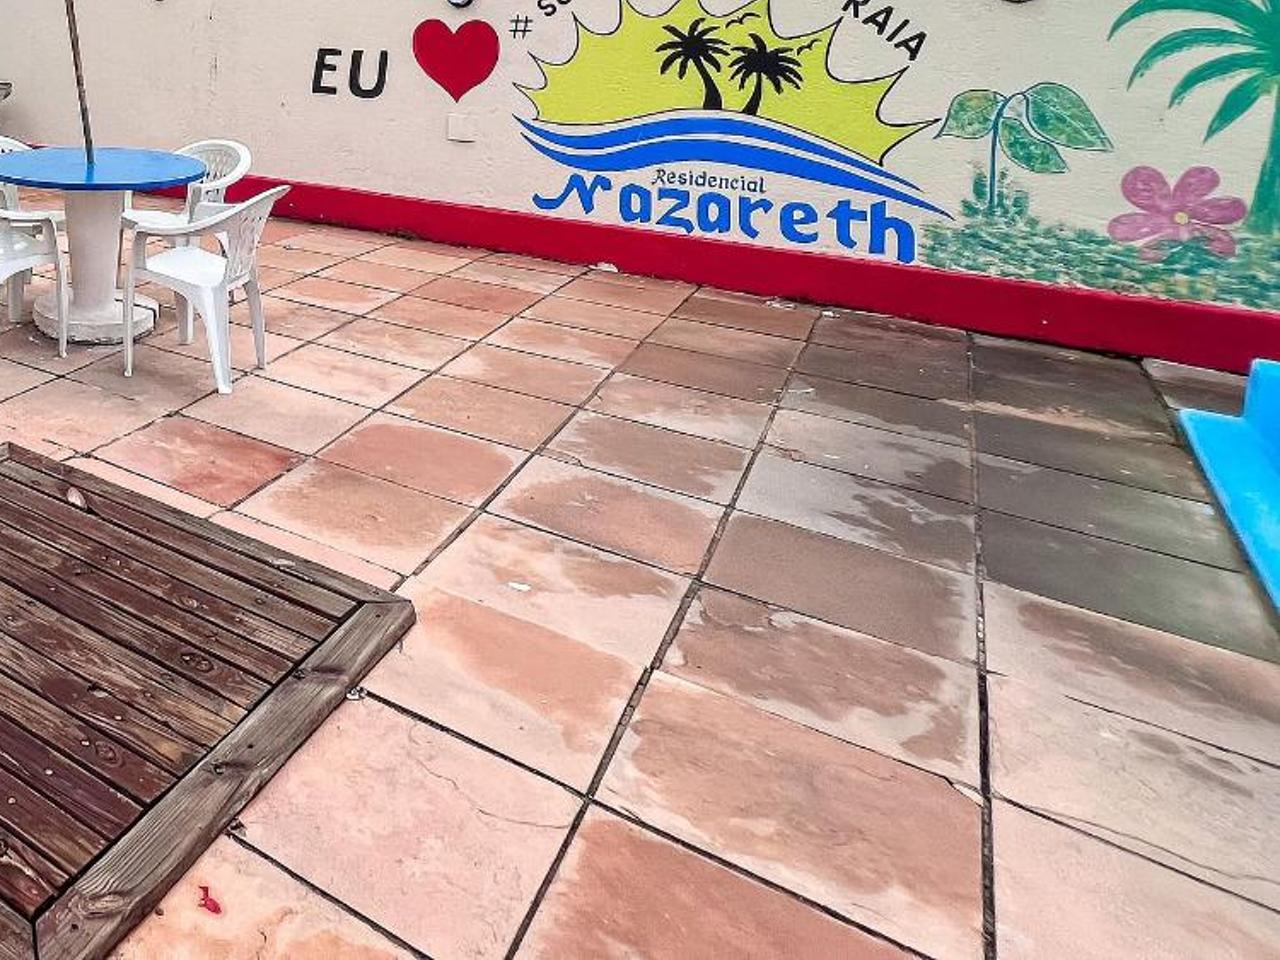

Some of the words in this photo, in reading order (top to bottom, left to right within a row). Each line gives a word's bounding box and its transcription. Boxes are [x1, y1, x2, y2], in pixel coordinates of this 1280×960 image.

[312, 48, 389, 98] EU
[652, 168, 766, 193] Residencial
[532, 172, 916, 264] Nazareth
